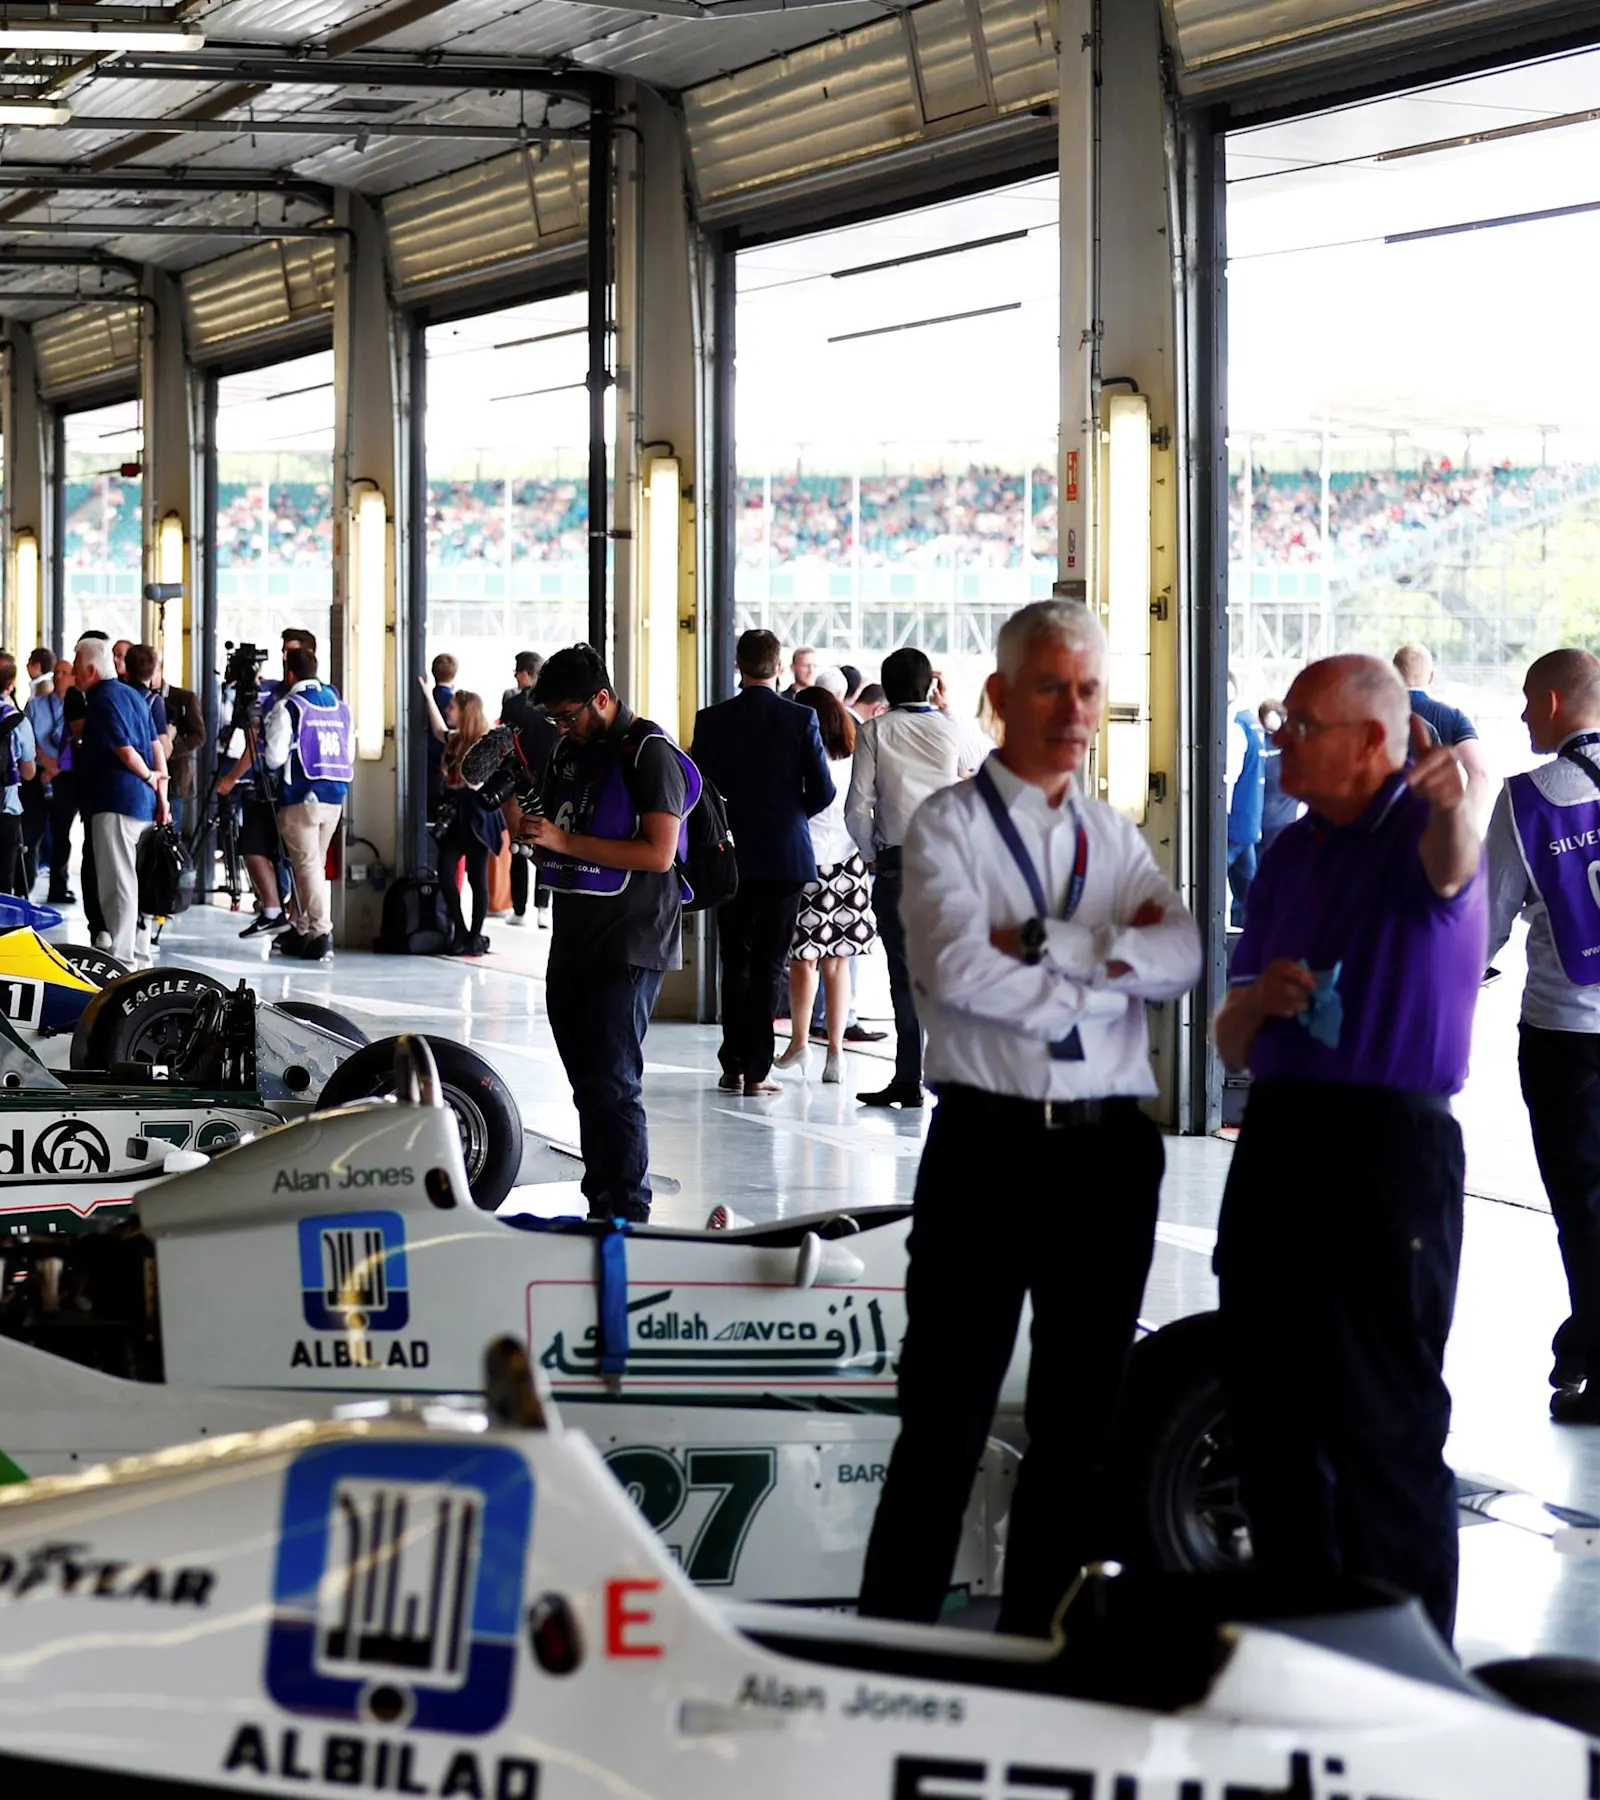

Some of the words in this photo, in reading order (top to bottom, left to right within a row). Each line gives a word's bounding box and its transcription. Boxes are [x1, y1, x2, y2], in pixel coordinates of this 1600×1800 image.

[1549, 829, 1600, 856] SILVE
[8, 983, 25, 1018] 1
[122, 979, 189, 1017] EAGLE
[273, 1169, 330, 1194] Alan
[338, 1164, 416, 1189] Jones
[636, 1314, 708, 1342] dallah
[838, 1463, 886, 1484] BAR
[605, 1579, 665, 1659] E
[738, 1673, 826, 1712] Alan
[841, 1684, 965, 1724] Jones
[221, 1722, 542, 1800] ALBILAD
